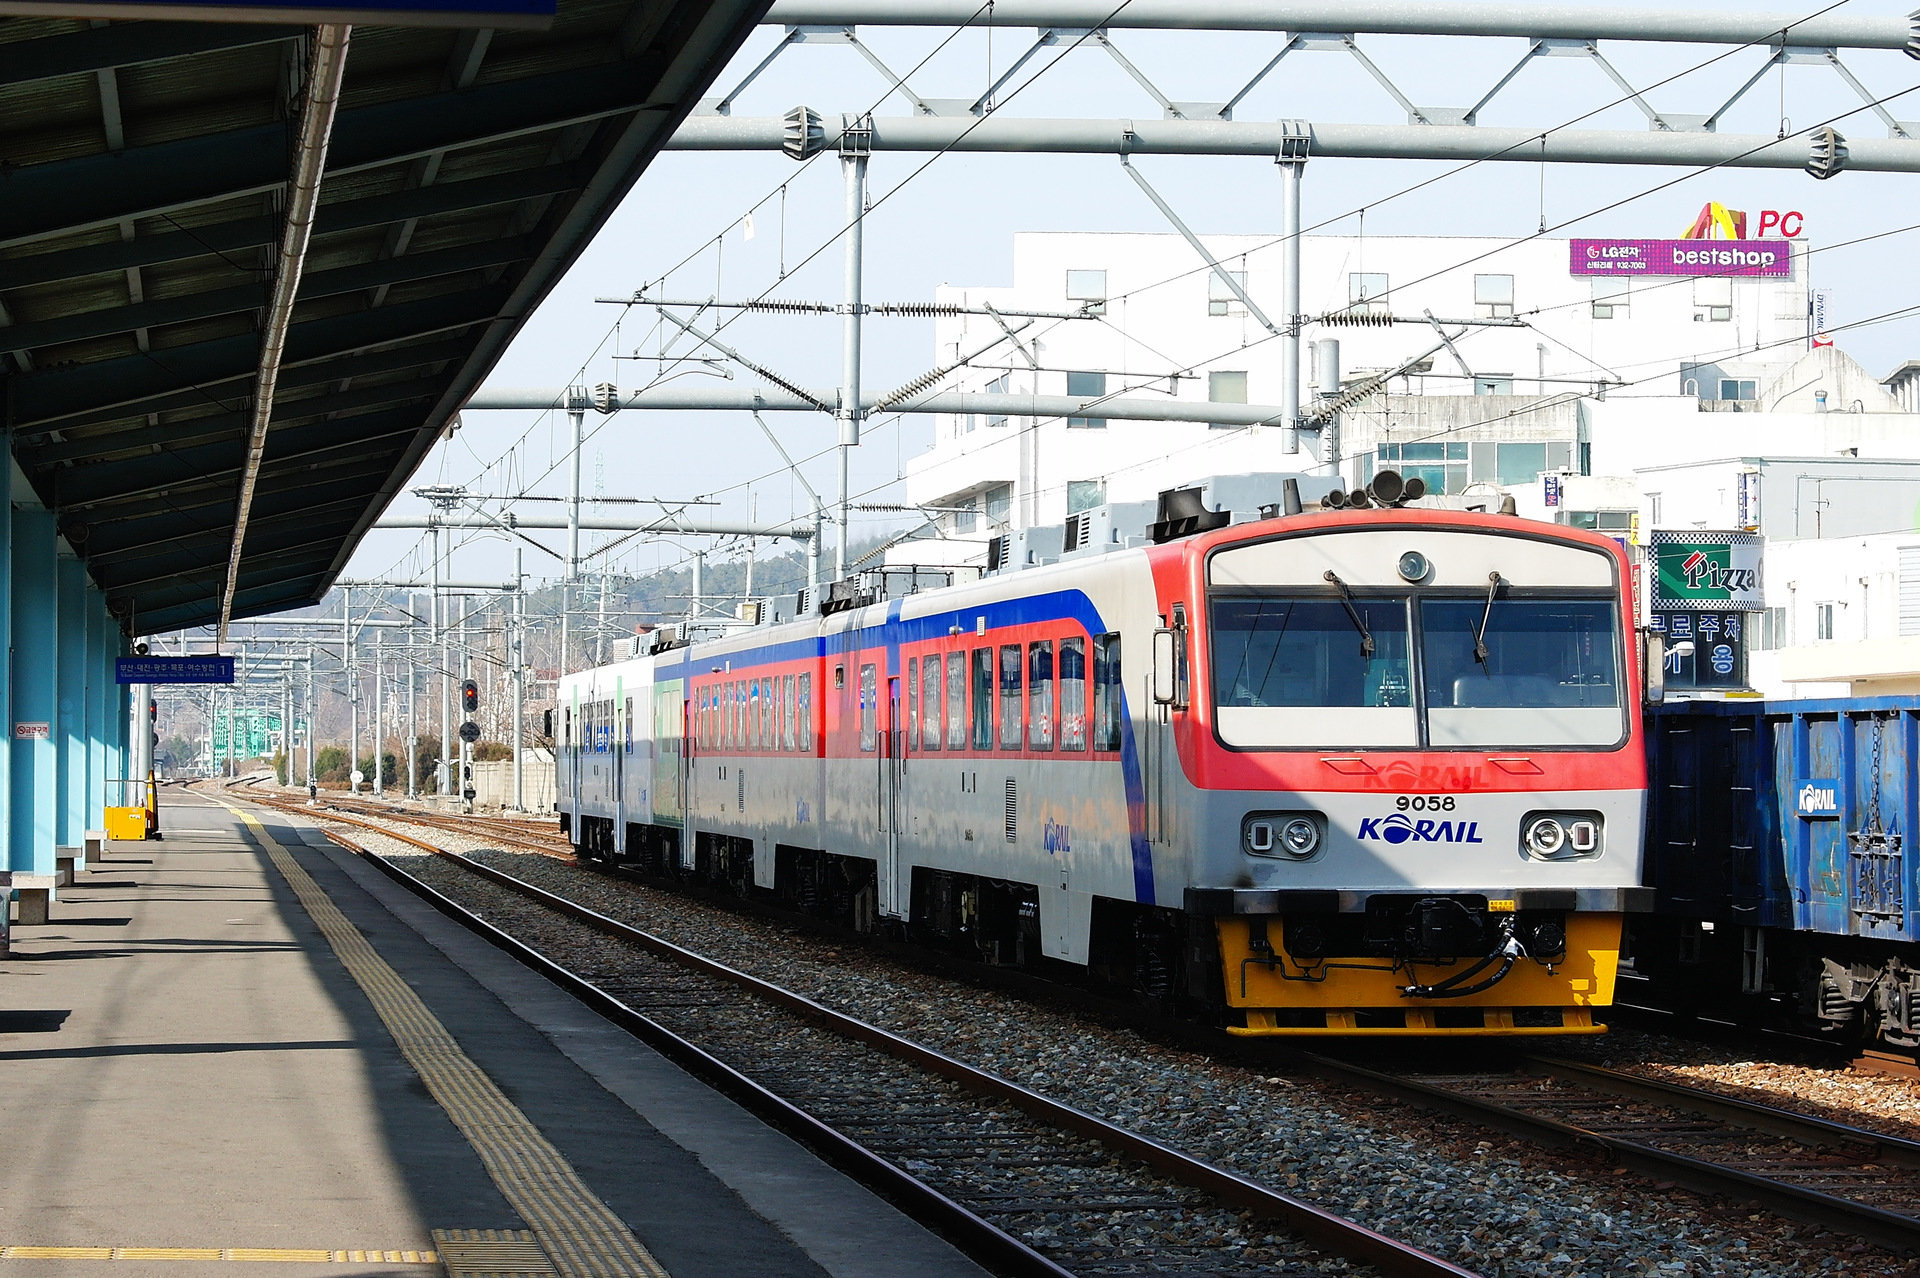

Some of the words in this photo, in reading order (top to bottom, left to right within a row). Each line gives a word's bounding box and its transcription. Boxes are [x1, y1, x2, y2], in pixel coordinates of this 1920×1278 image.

[1758, 210, 1803, 238] PC
[1673, 247, 1775, 268] bestshop
[1684, 552, 1756, 592] Pizza
[1396, 796, 1455, 811] 9058
[1798, 783, 1837, 814] KORAIL
[1357, 813, 1483, 844] KORAIL
